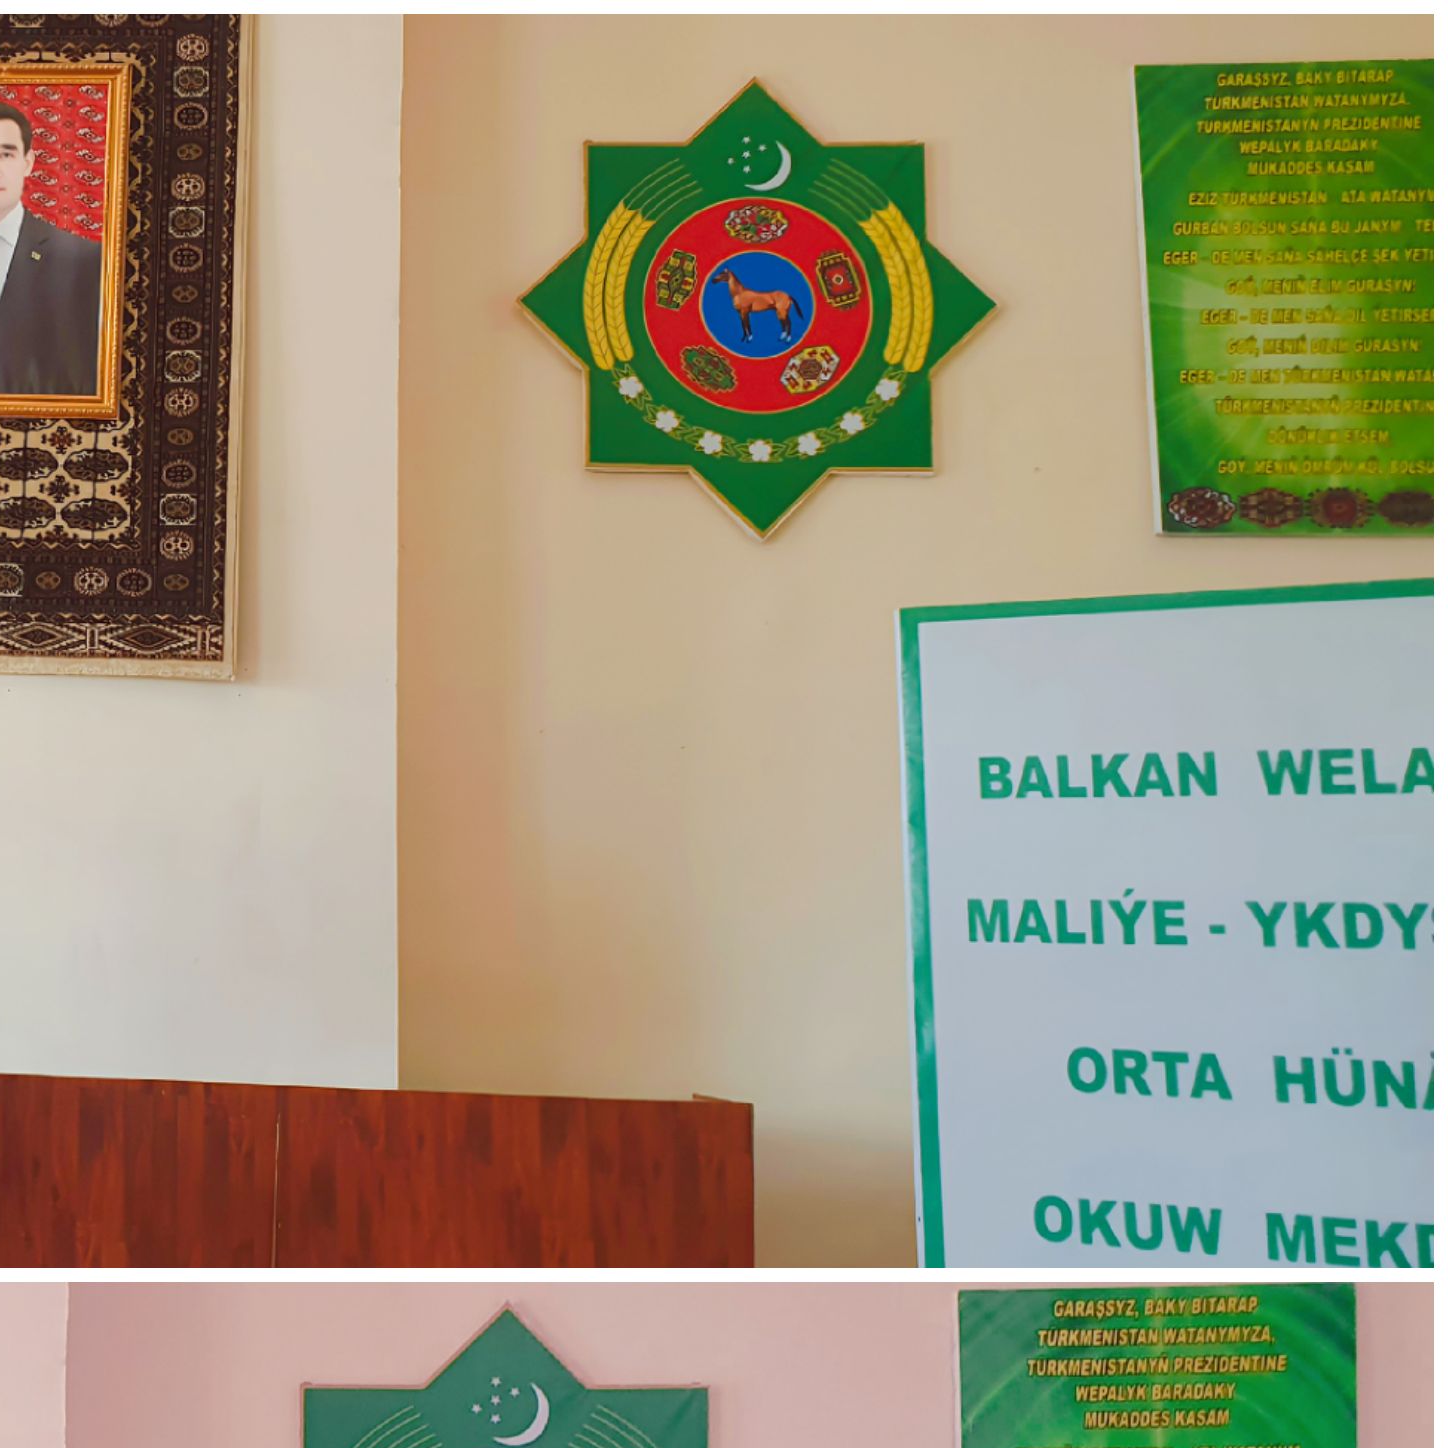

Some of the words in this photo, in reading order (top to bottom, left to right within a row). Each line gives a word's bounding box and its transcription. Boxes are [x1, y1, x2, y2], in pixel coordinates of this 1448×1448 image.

[1295, 72, 1330, 85] BAKY
[1336, 70, 1394, 84] BITARAP
[1324, 116, 1421, 131] PREZIDENTINE
[1239, 141, 1301, 154] WEPALYK
[1306, 139, 1378, 152] BARADAKY
[1247, 161, 1322, 176] MUKADDES
[1327, 160, 1375, 174] KASAM
[1341, 190, 1366, 204] ATA
[1173, 221, 1228, 236] GURBAN
[1233, 221, 1286, 236] BOLSUN
[1331, 220, 1349, 233] BU
[1354, 219, 1401, 233] JANYM
[1163, 251, 1198, 265] EGER
[1200, 309, 1237, 324] EGER
[1180, 369, 1215, 384] EGER
[978, 751, 1218, 799] BALKAN
[967, 888, 1189, 945] MALIÝE
[1209, 924, 1227, 935] -
[1244, 901, 1434, 950] YKDY
[1066, 1046, 1233, 1101] ORTA
[1273, 1047, 1434, 1111] HÜN
[1033, 1195, 1222, 1256] OKUW
[1054, 1299, 1139, 1319] GARAŞSYZ,
[1144, 1298, 1187, 1315] BAKY
[1192, 1296, 1258, 1314] BITARAP
[1173, 1354, 1288, 1373] PREZIDENTINE
[1075, 1385, 1146, 1402] WEPALYK
[1151, 1383, 1235, 1401] BARADAKY
[1084, 1410, 1170, 1429] MUKADDES
[1175, 1408, 1230, 1427] KASAM
